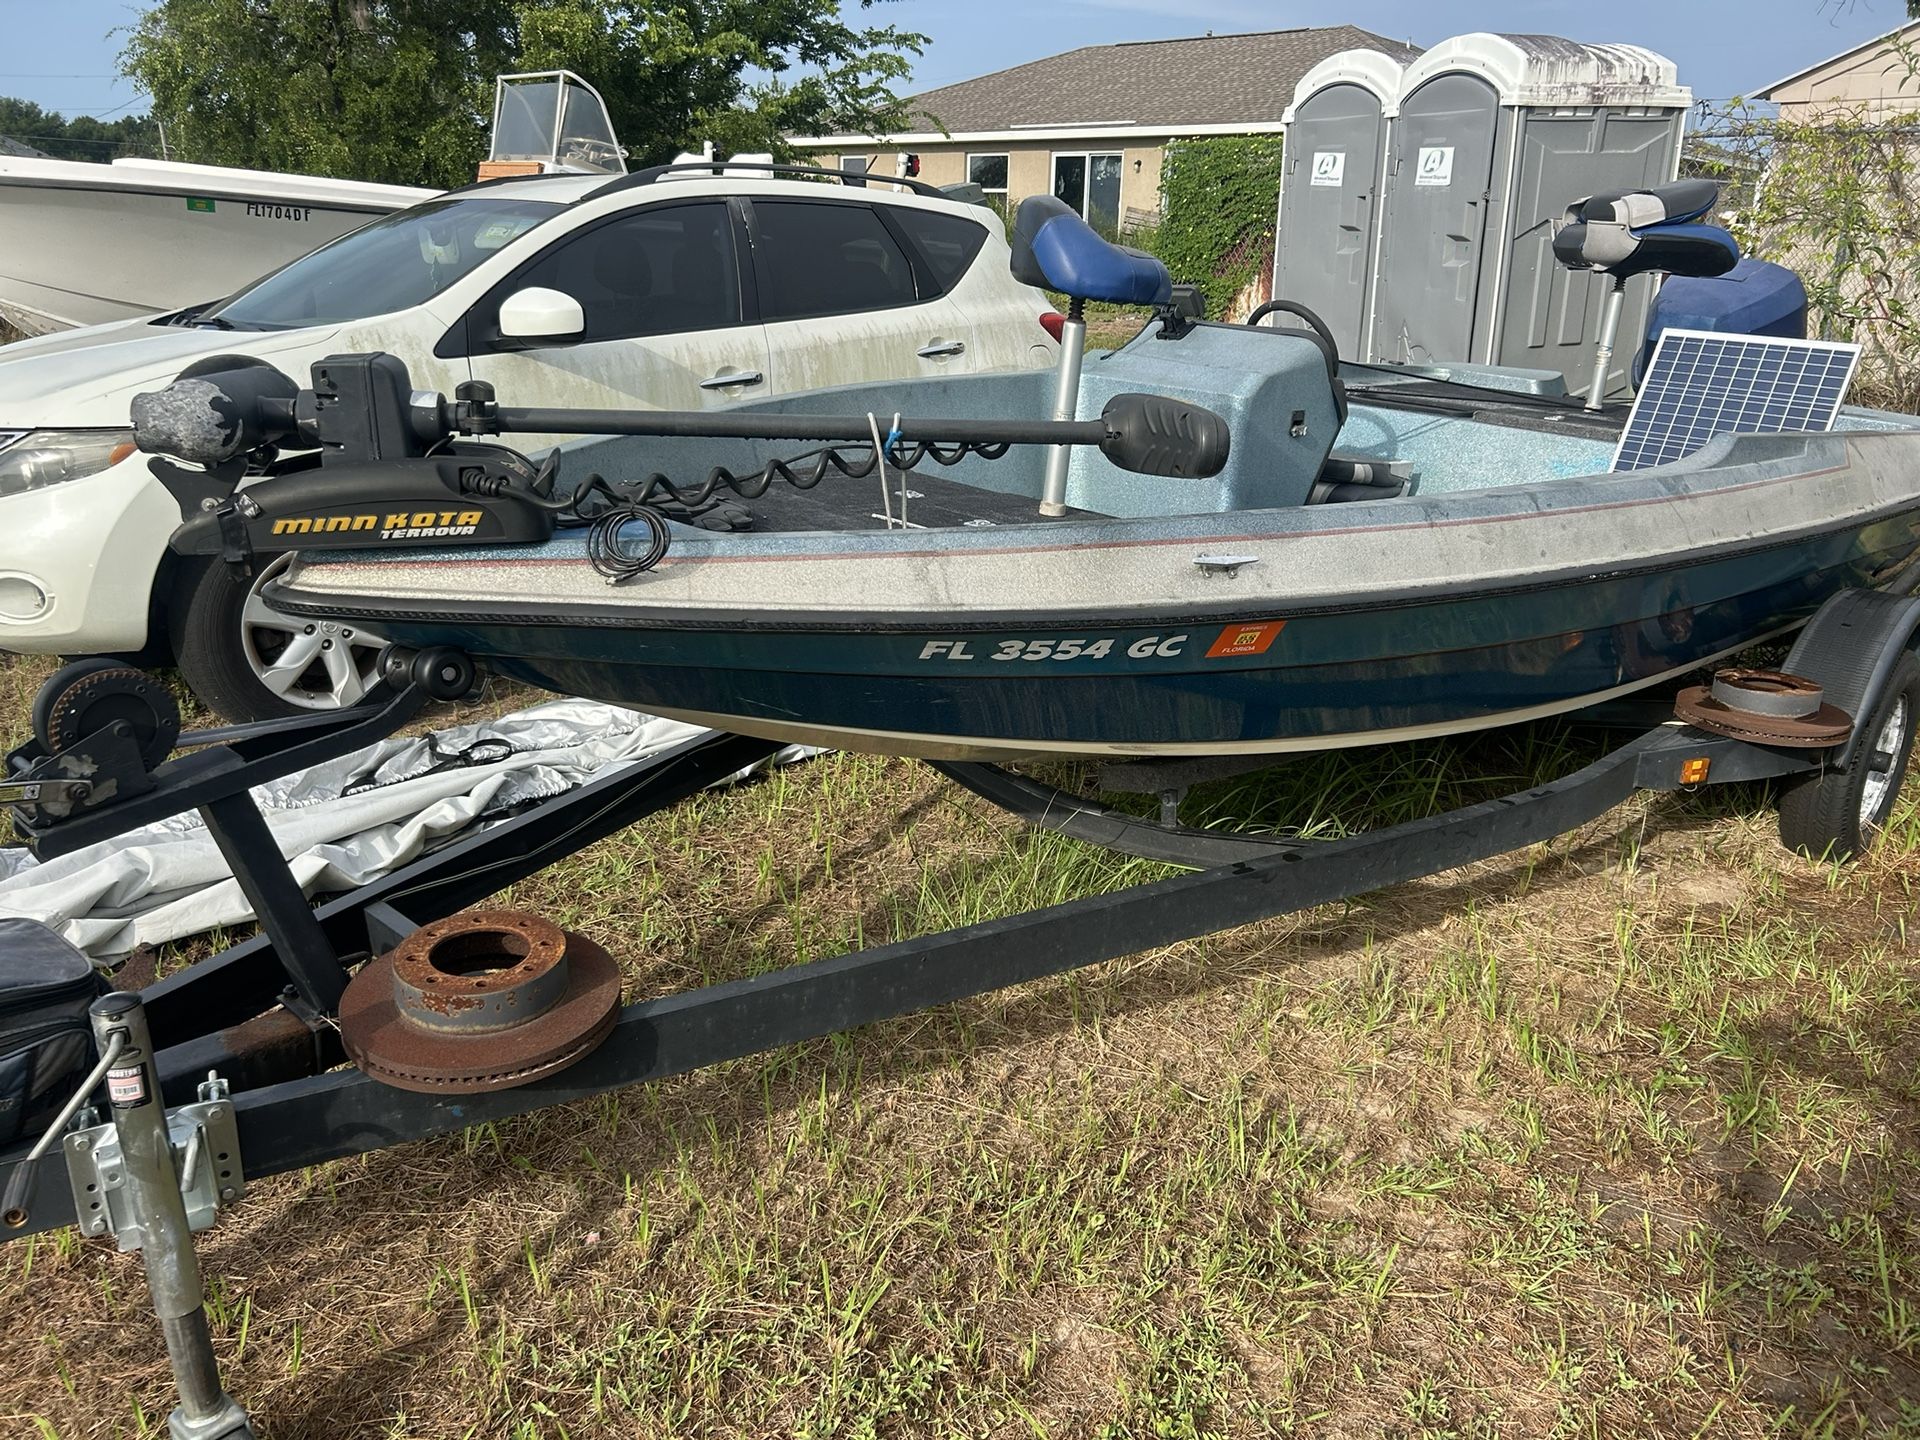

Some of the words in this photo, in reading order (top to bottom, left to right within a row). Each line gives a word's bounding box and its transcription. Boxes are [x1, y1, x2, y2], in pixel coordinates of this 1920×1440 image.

[272, 514, 378, 535] MINN
[383, 511, 483, 530] KOTA
[379, 525, 476, 540] TERROVA
[919, 640, 975, 660] FL
[991, 638, 1114, 662] 3554
[1127, 635, 1188, 659] GC
[1221, 645, 1256, 654] FLORIDA
